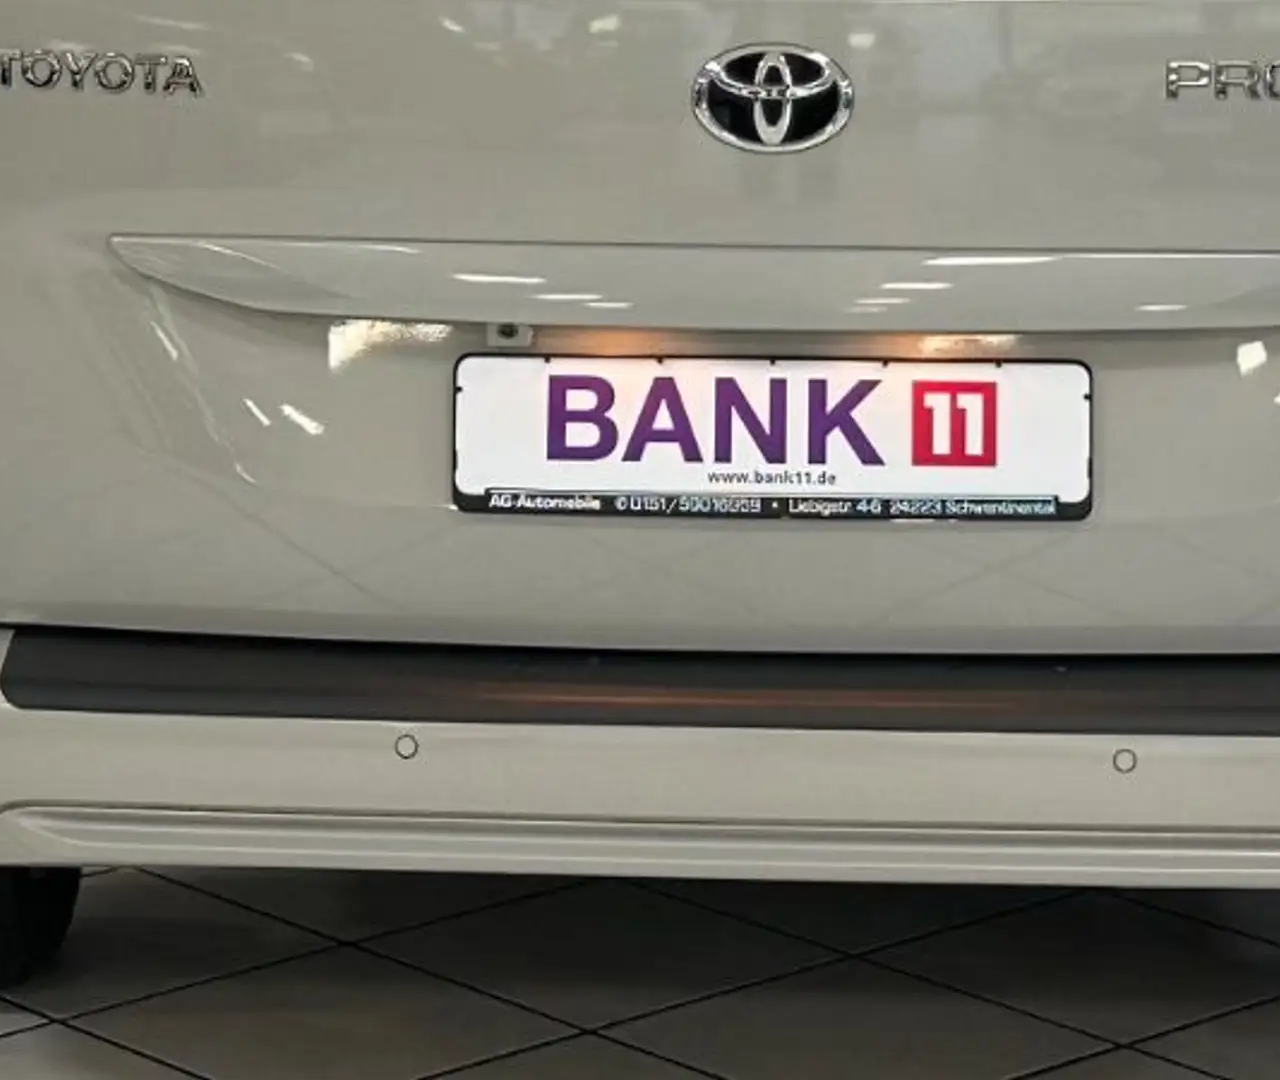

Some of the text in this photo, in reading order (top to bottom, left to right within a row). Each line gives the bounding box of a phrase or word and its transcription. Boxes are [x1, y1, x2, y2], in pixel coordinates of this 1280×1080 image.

[545, 373, 987, 467] BANK 11
[707, 469, 837, 486] www.bank11.de
